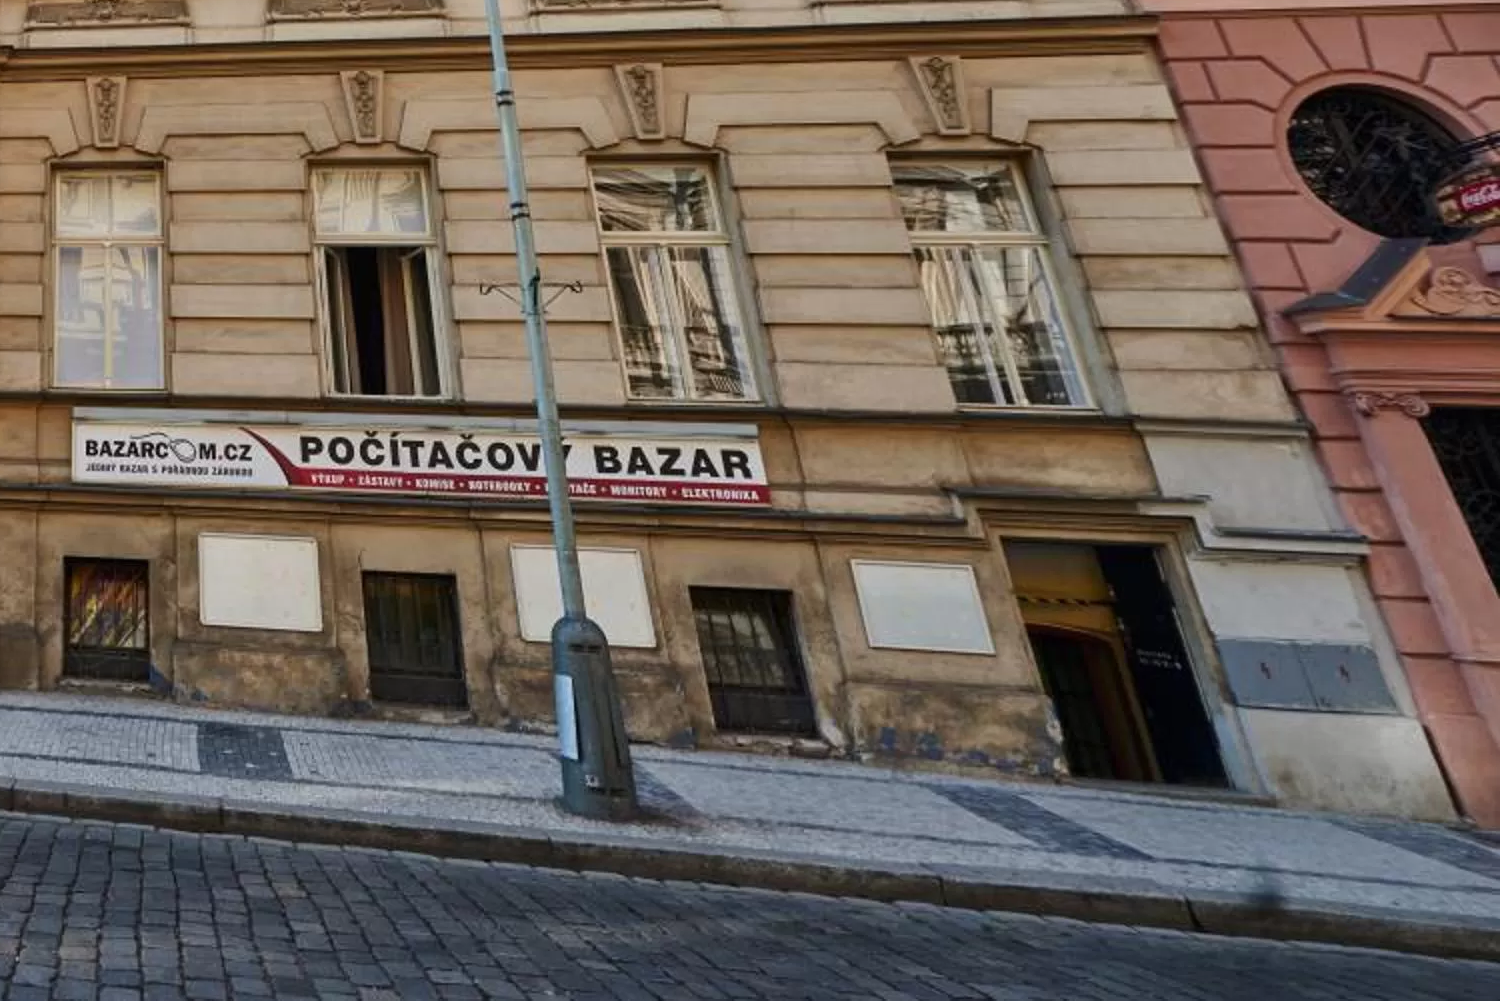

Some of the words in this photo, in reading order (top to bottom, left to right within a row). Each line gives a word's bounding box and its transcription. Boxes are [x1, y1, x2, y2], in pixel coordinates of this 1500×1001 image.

[594, 445, 752, 479] BAZAR
[611, 485, 667, 498] MONITORY
[681, 488, 760, 501] ELEKTRONIKA
